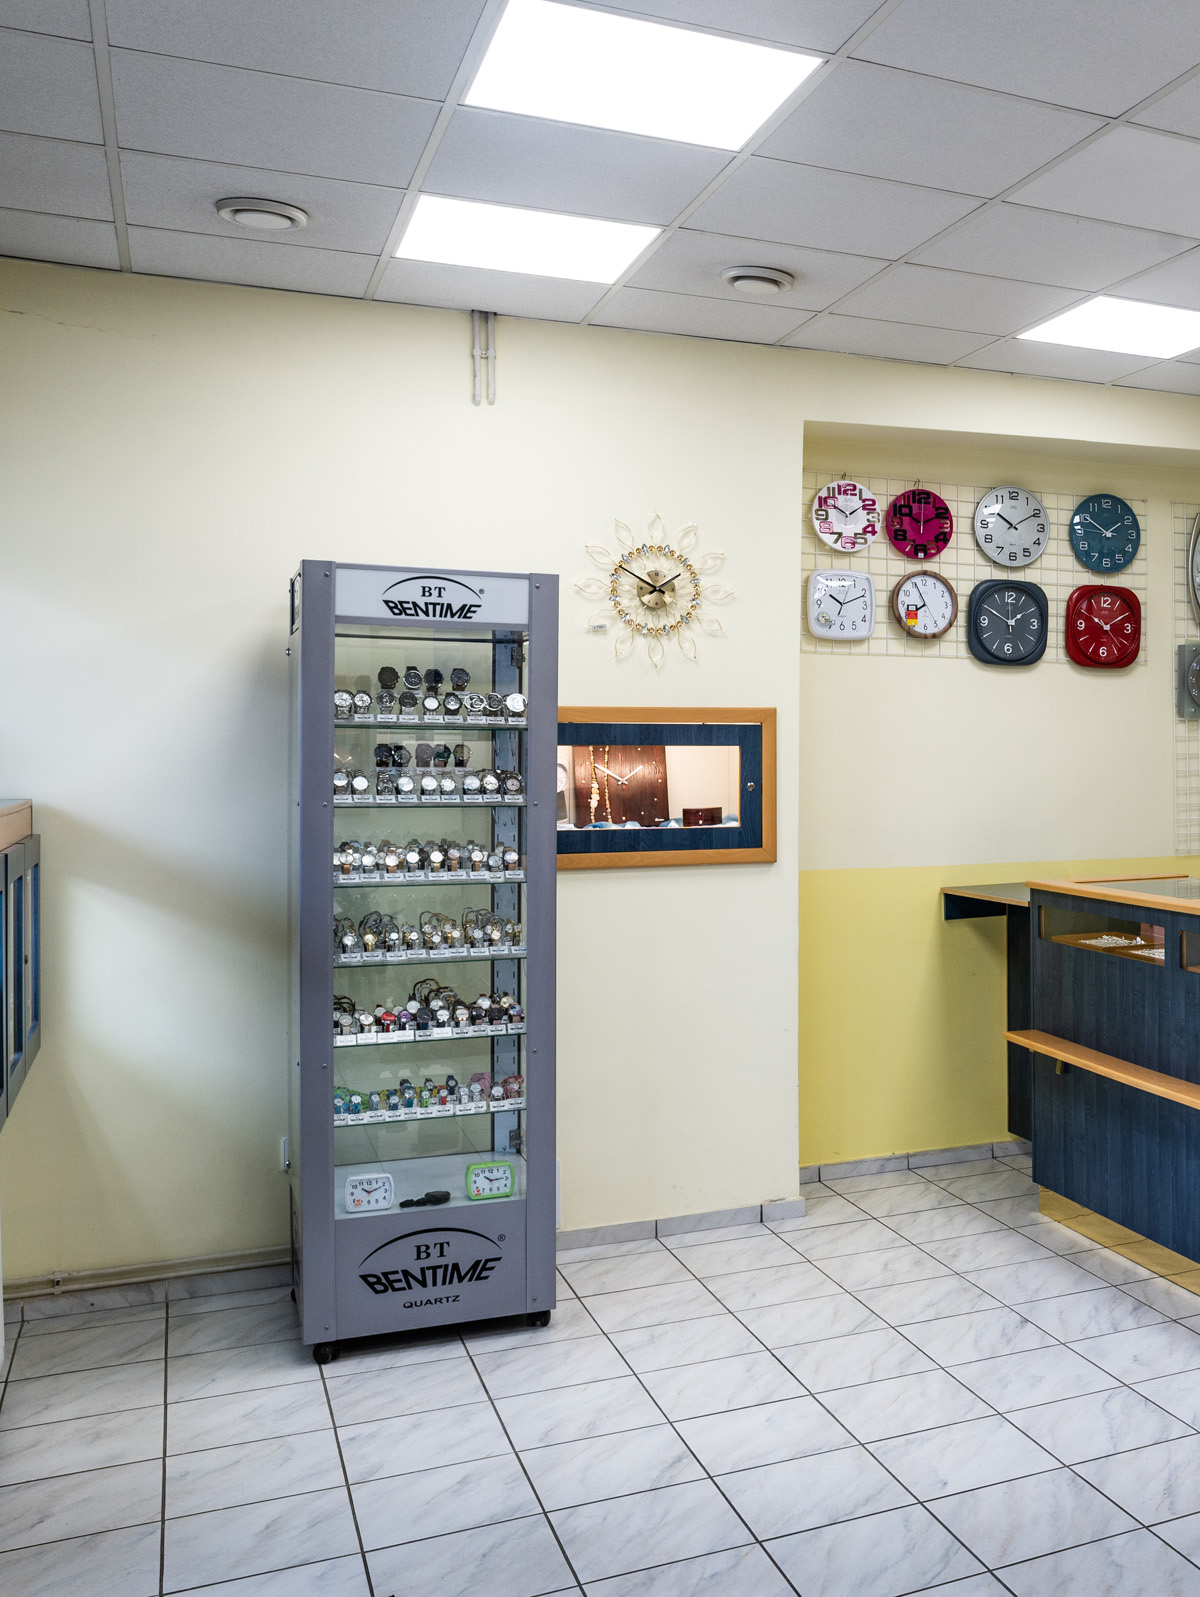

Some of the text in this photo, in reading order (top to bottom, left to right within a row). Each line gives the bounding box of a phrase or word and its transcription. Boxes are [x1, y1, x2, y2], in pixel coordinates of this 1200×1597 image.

[827, 486, 835, 497] 11
[837, 483, 857, 497] 12
[859, 488, 862, 500] 1
[911, 491, 931, 504] 12
[995, 495, 1004, 504] 11
[1008, 491, 1019, 500] 12
[818, 496, 838, 509] 10
[862, 498, 877, 511] 2
[1025, 497, 1029, 506] 1
[1101, 499, 1112, 509] 12
[1089, 503, 1097, 512] 11
[1117, 504, 1121, 513] 1
[815, 509, 829, 521] 9
[866, 511, 880, 524] 3
[934, 507, 949, 519] 2
[1033, 508, 1041, 518] 2
[890, 516, 903, 529] 9
[1080, 514, 1090, 523] 10
[1124, 516, 1132, 525] 2
[819, 521, 834, 533] 8
[862, 523, 878, 536] 4
[939, 519, 950, 532] 3
[980, 520, 989, 529] 9
[1037, 523, 1045, 533] 3
[830, 532, 843, 544] 7
[854, 533, 867, 545] 5
[893, 529, 907, 541] 8
[934, 532, 949, 544] 4
[984, 534, 993, 543] 8
[1128, 530, 1136, 540] 3
[841, 536, 855, 549] 6
[1033, 537, 1041, 546] 4
[1080, 541, 1088, 550] 8
[913, 544, 928, 556] 6
[996, 546, 1004, 555] 7
[1023, 548, 1031, 557] 5
[1125, 544, 1133, 553] 4
[1009, 552, 1017, 561] 6
[1090, 553, 1098, 562] 7
[1115, 554, 1123, 564] 5
[1102, 558, 1111, 568] 6
[853, 579, 856, 589] 1
[933, 582, 937, 590] 1
[420, 585, 446, 598] BT
[861, 588, 867, 598] 2
[1005, 592, 1016, 603] 12
[1101, 597, 1111, 608] 12
[816, 599, 822, 609] 9
[862, 601, 868, 610] 3
[382, 599, 483, 620] BENTIME
[861, 615, 867, 623] 4
[941, 612, 946, 620] 4
[980, 615, 989, 627] 9
[839, 621, 845, 631] 6
[851, 621, 857, 631] 5
[923, 623, 928, 631] 6
[934, 620, 938, 628] 5
[1030, 619, 1038, 630] 3
[1077, 620, 1085, 631] 9
[1124, 623, 1132, 634] 3
[1004, 643, 1012, 654] 6
[1099, 646, 1107, 657] 6
[414, 1241, 450, 1261] BT
[359, 1256, 503, 1295] BENTIME
[403, 1294, 461, 1309] QUARTZ
